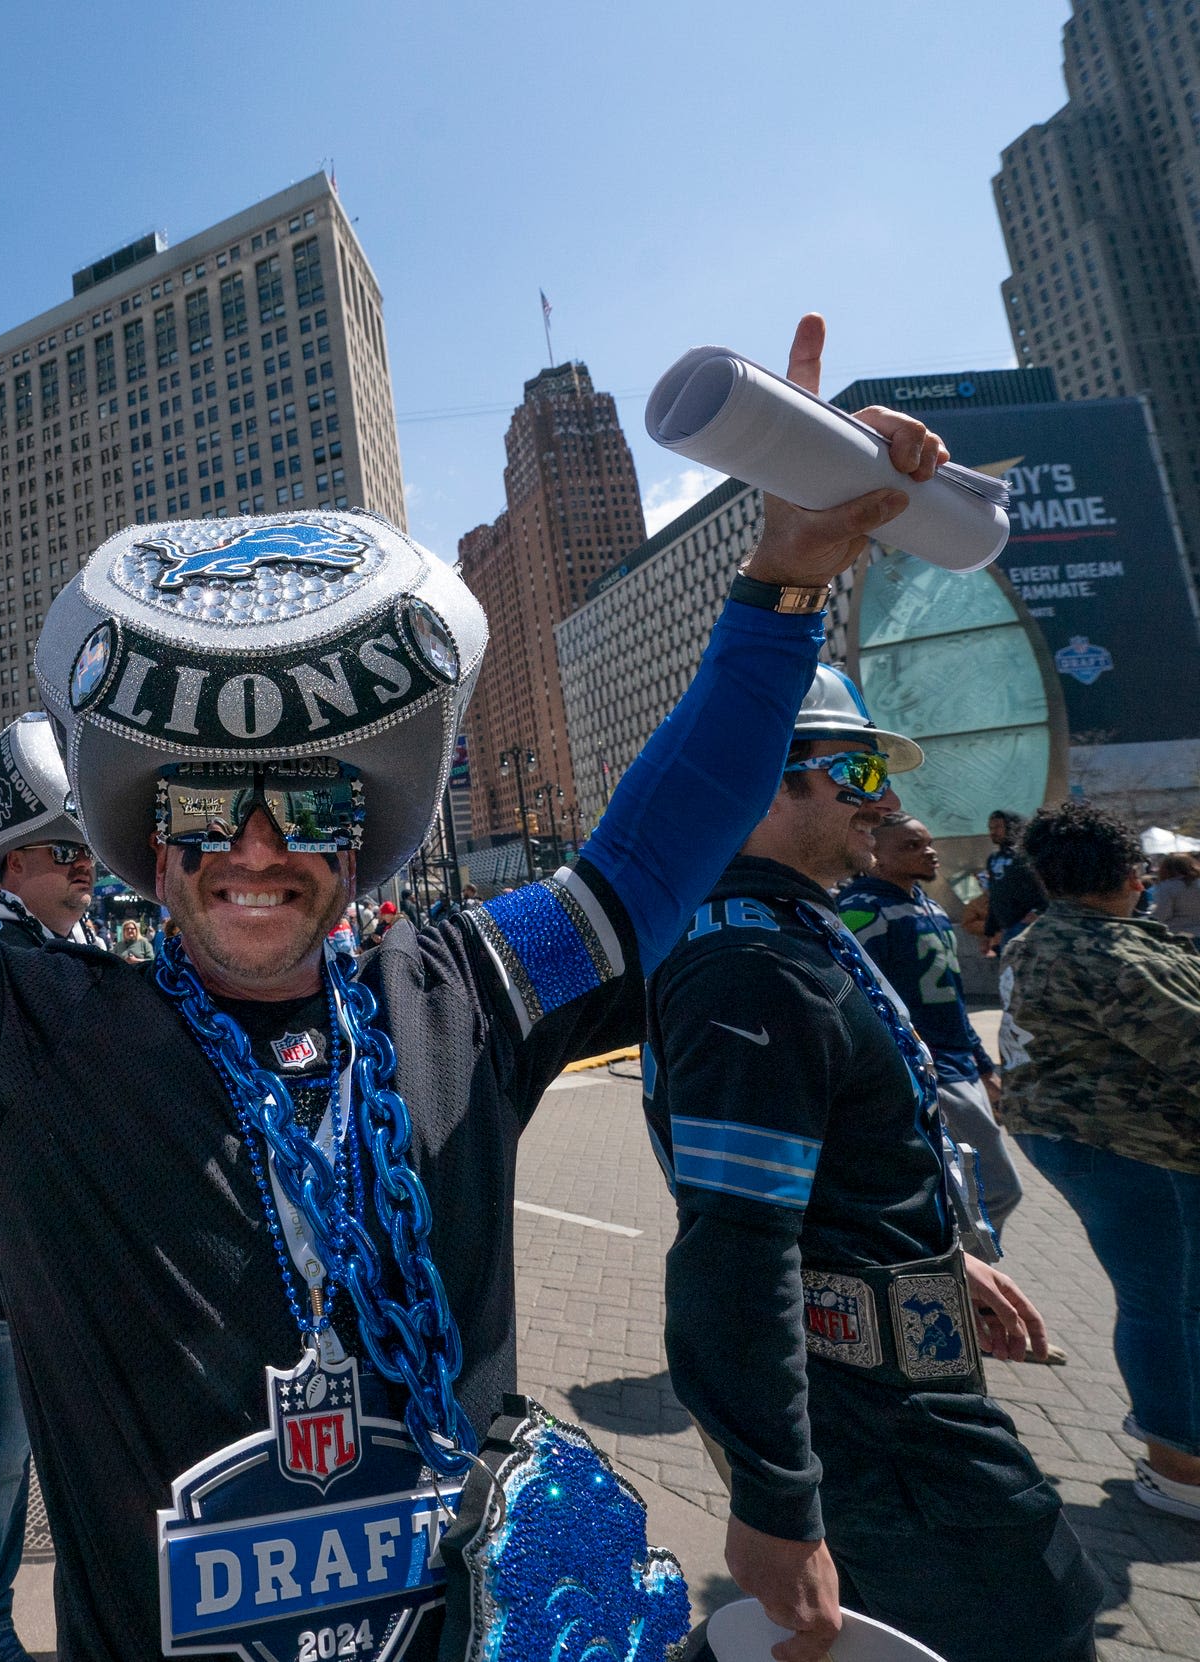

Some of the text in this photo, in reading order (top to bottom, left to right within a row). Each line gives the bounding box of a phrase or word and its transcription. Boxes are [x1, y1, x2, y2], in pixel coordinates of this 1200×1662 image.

[895, 384, 957, 399] CHASE
[1004, 463, 1076, 495] OY'S
[1009, 496, 1116, 530] -MADE.
[1010, 561, 1124, 583] EVERY DREAM
[1013, 581, 1096, 599] EAMMATE.
[108, 631, 413, 739] LIONS
[8, 773, 38, 813] BOWL
[201, 842, 338, 853] NFL DRAFT
[687, 897, 782, 942] 16
[280, 1043, 312, 1062] NFL
[808, 1306, 858, 1341] NFL
[287, 1413, 356, 1476] NFL
[195, 1508, 455, 1617] DRAFT
[297, 1618, 375, 1662] 2024
